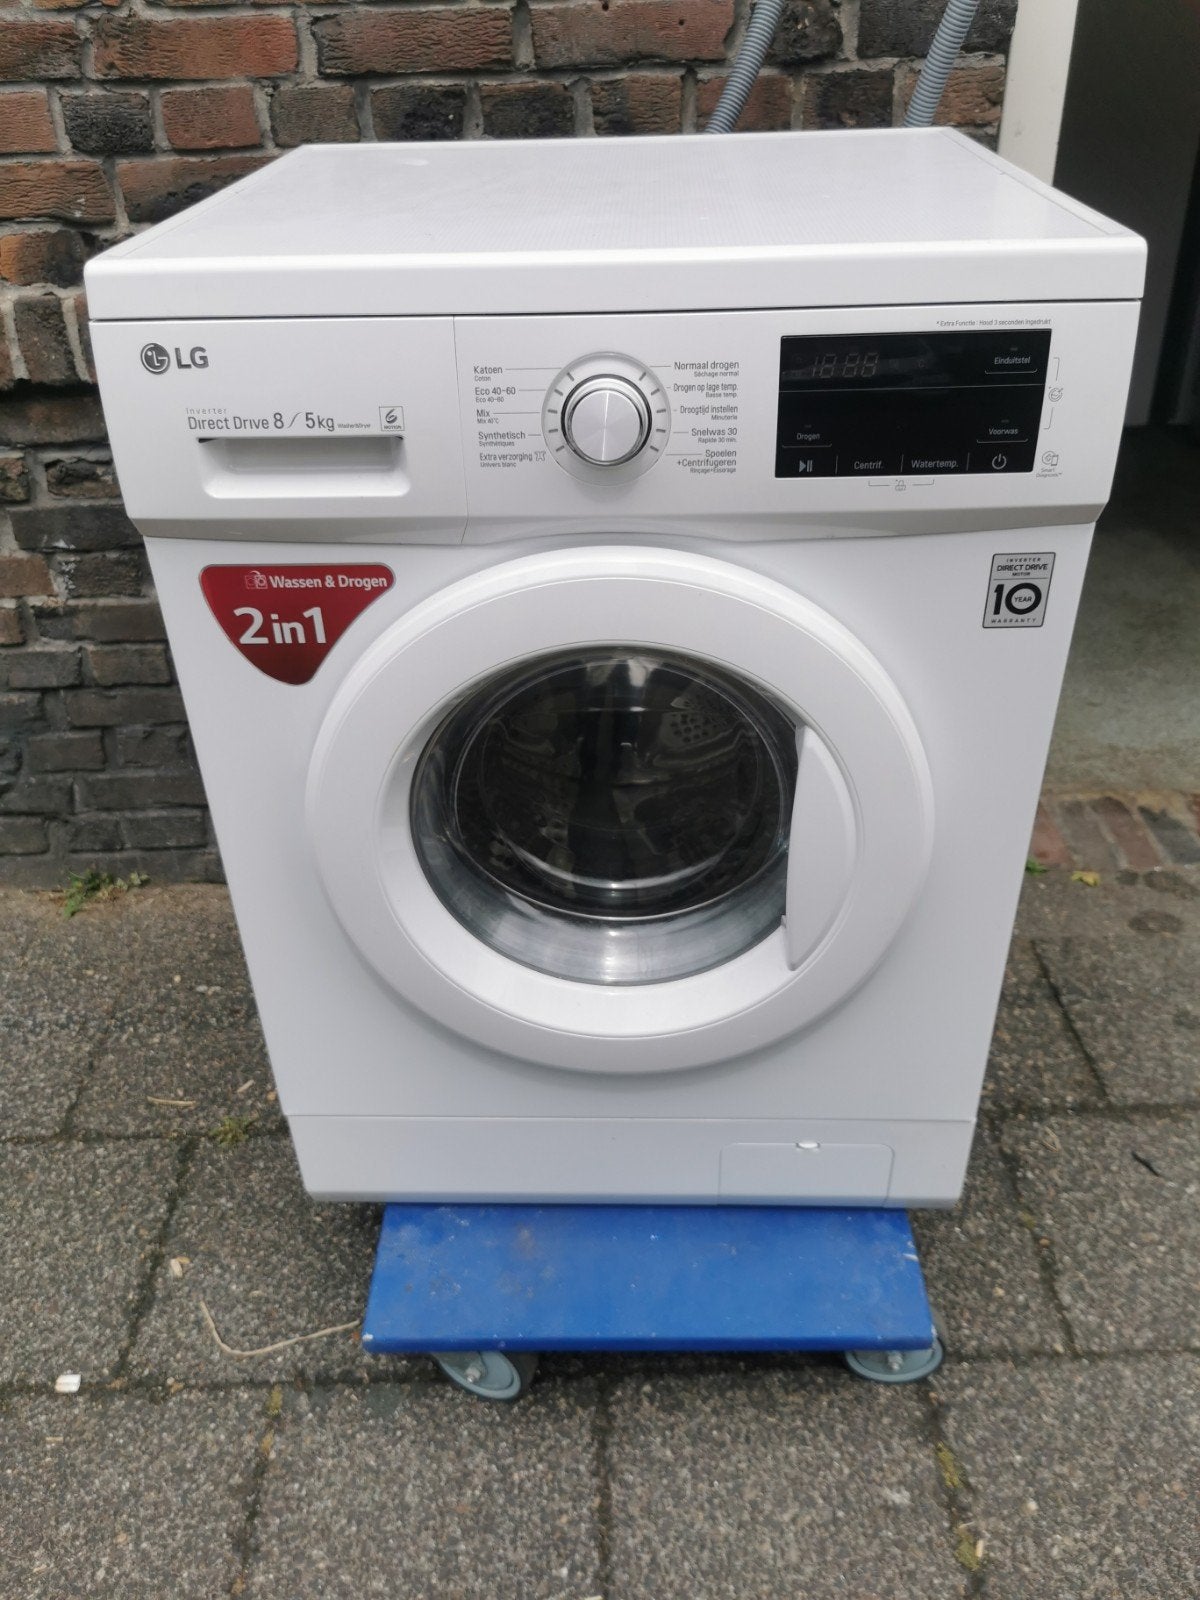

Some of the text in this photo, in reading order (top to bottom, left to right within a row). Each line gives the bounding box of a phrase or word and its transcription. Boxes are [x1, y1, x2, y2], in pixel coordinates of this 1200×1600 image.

[174, 346, 209, 370] LG
[994, 356, 1031, 365] Einduitstel
[473, 366, 503, 374] Katoen
[674, 360, 740, 370] Normaal drogen
[475, 386, 516, 396] Eco 40-60
[673, 383, 696, 394] Drogen
[696, 384, 706, 392] op
[706, 382, 720, 392] lage
[476, 409, 490, 417] Mix
[680, 404, 738, 416] Droogtijd instellen
[188, 416, 230, 430] Direct
[232, 416, 270, 430] Drive
[478, 431, 526, 440] Synthetisch
[691, 427, 738, 436] Snelwas 30
[796, 432, 821, 441] Drogen
[480, 452, 533, 462] Extra verzorging
[705, 449, 736, 458] Spoelen
[854, 459, 958, 470] Centrif. Watertemp.
[996, 563, 1048, 572] DIRECT DRIVE
[269, 574, 388, 591] Wassen & Drogen
[993, 582, 1042, 616] 10
